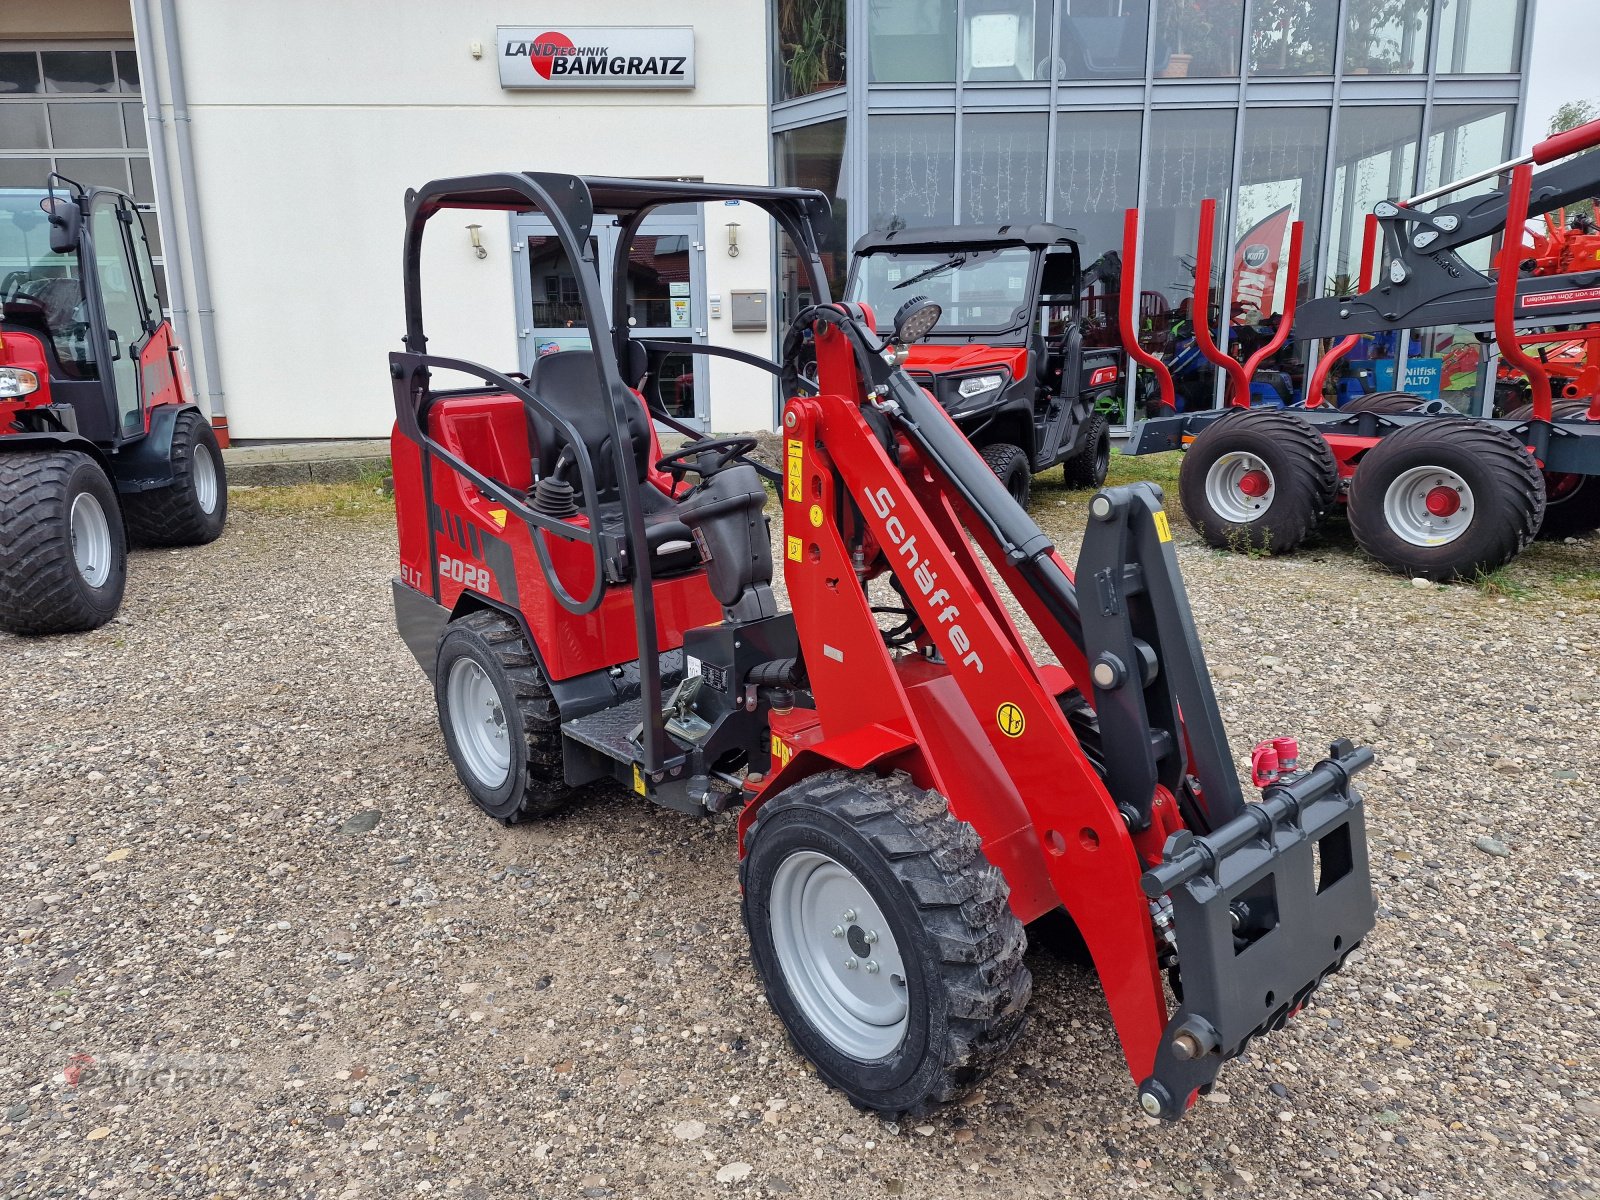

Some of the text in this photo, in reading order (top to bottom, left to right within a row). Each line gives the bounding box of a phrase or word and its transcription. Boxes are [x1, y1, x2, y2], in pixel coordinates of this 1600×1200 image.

[552, 56, 687, 75] BAMGRATZ
[1404, 366, 1437, 376] Nilfisk
[1404, 376, 1430, 386] ALTO
[401, 563, 422, 588] SLT
[440, 553, 490, 594] 2028
[864, 486, 984, 674] Schäffer
